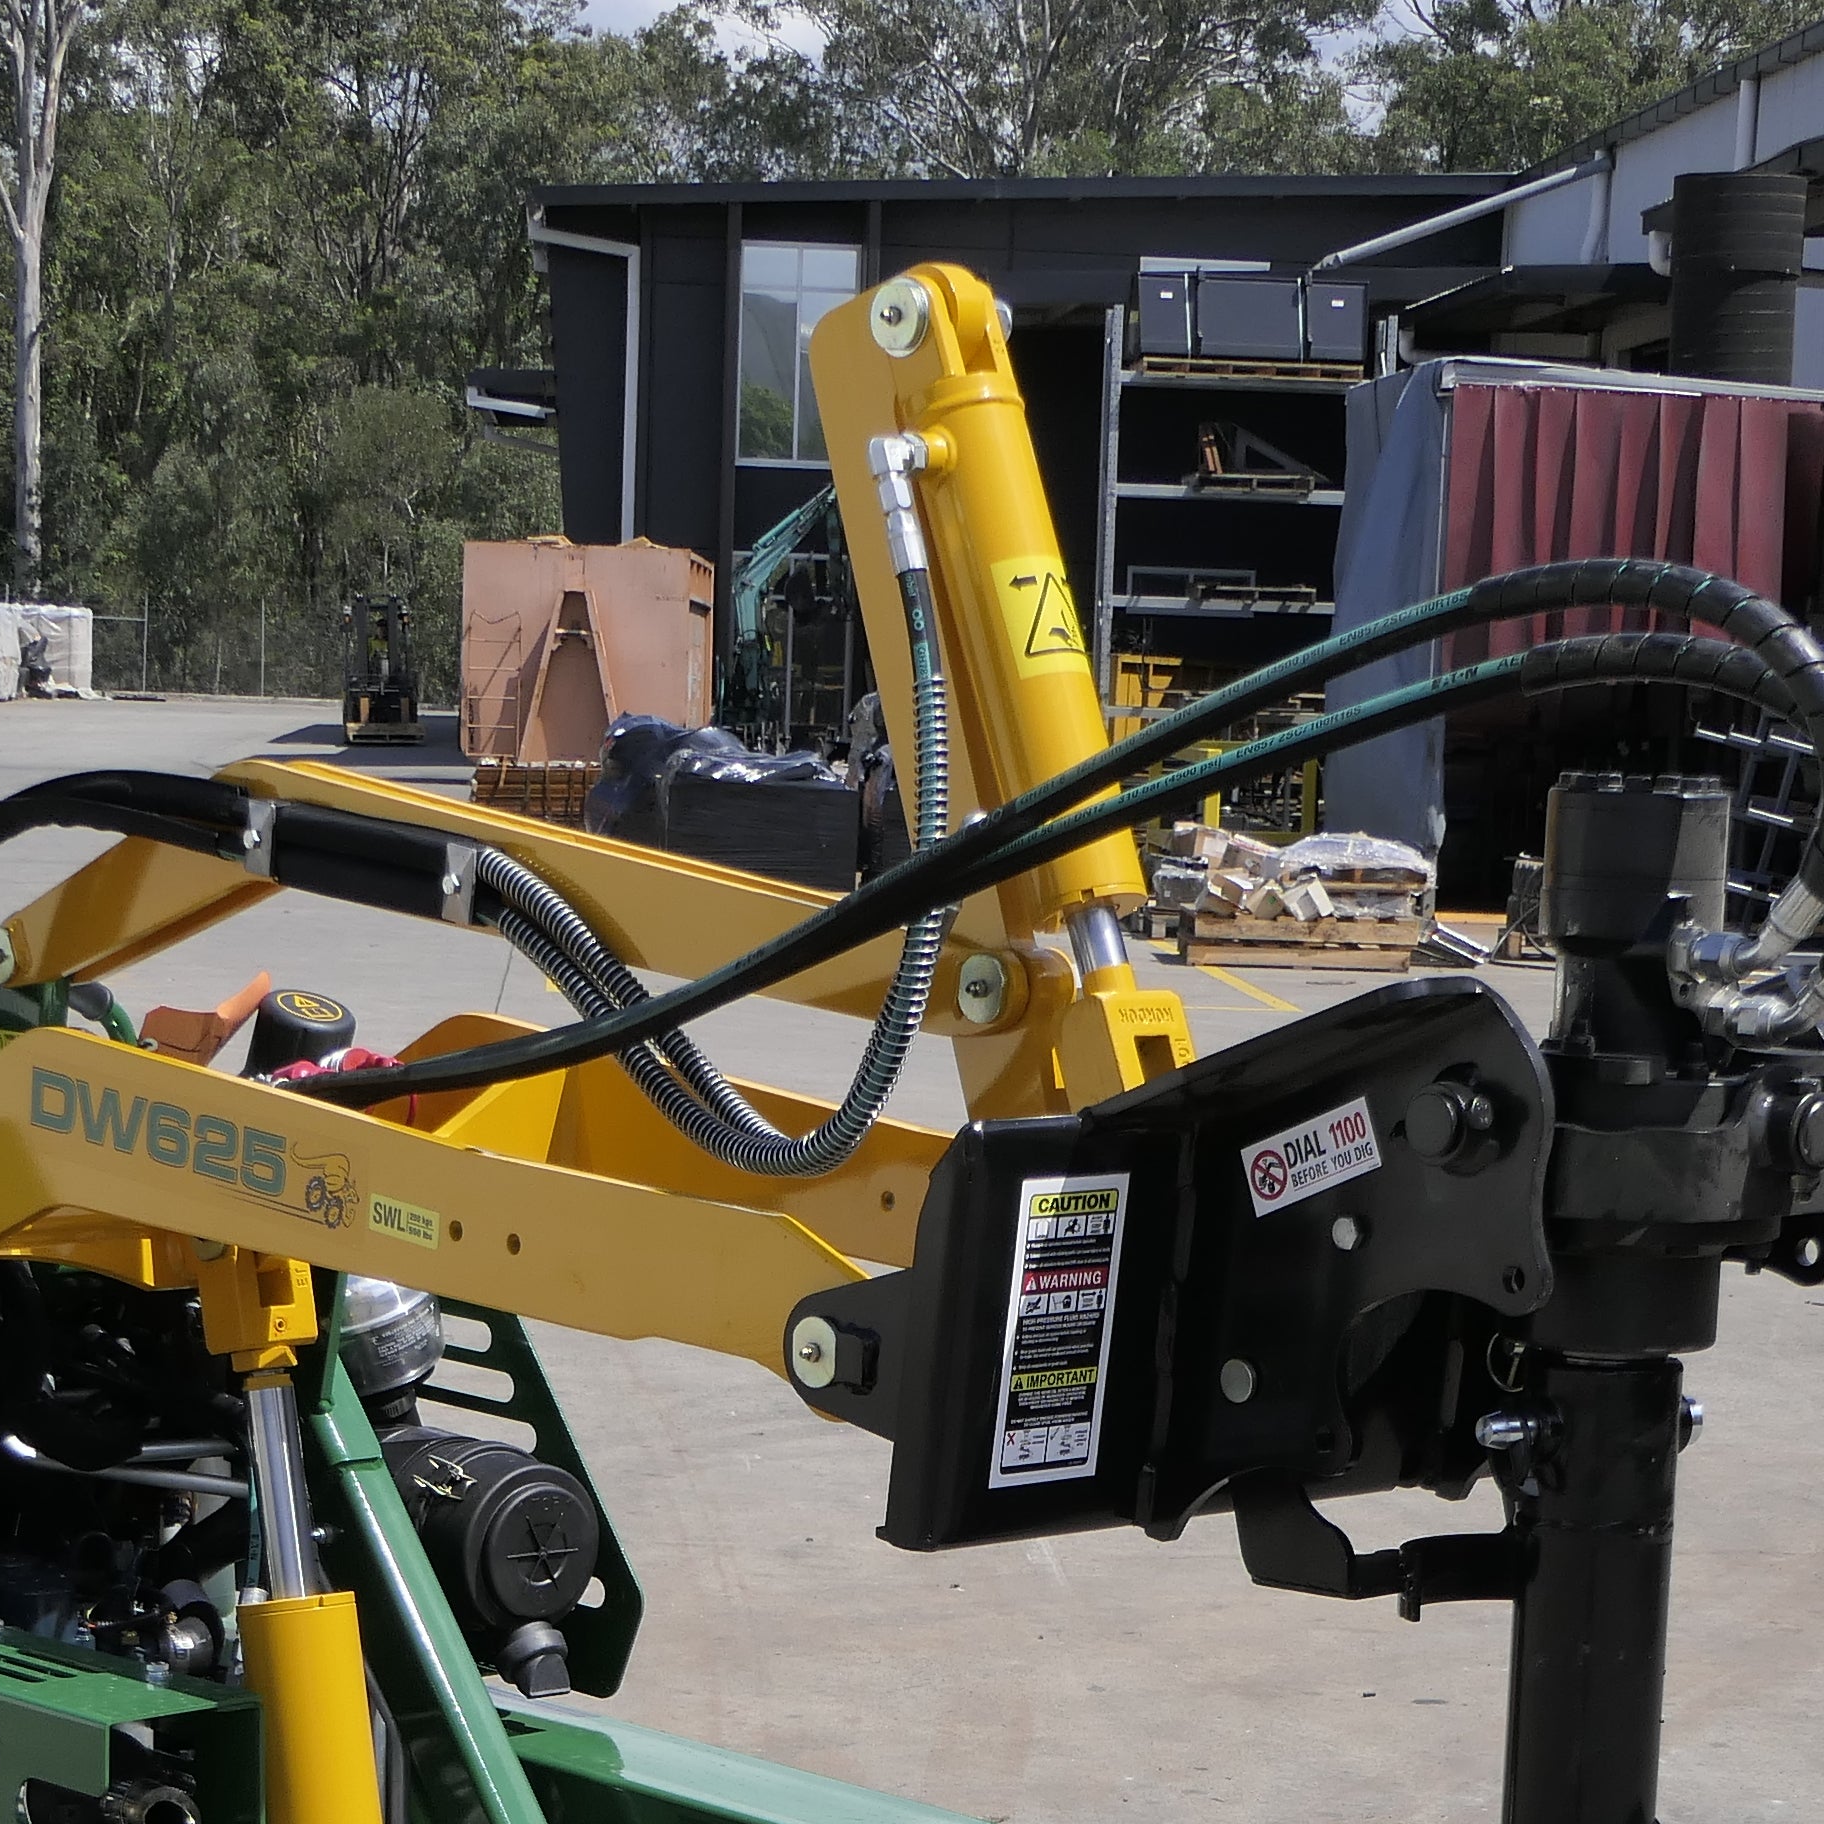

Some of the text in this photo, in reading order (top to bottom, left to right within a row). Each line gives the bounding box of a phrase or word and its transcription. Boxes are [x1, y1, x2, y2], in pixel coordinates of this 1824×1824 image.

[30, 1066, 287, 1197] DW625
[1283, 1111, 1366, 1169] DIAL 1100
[1291, 1141, 1374, 1187] BEFORE YOU DIG
[373, 1202, 406, 1232] SWL
[1038, 1193, 1111, 1213] CAUTION
[1039, 1271, 1102, 1290] WARNING
[1026, 1368, 1095, 1388] IMPORTANT
